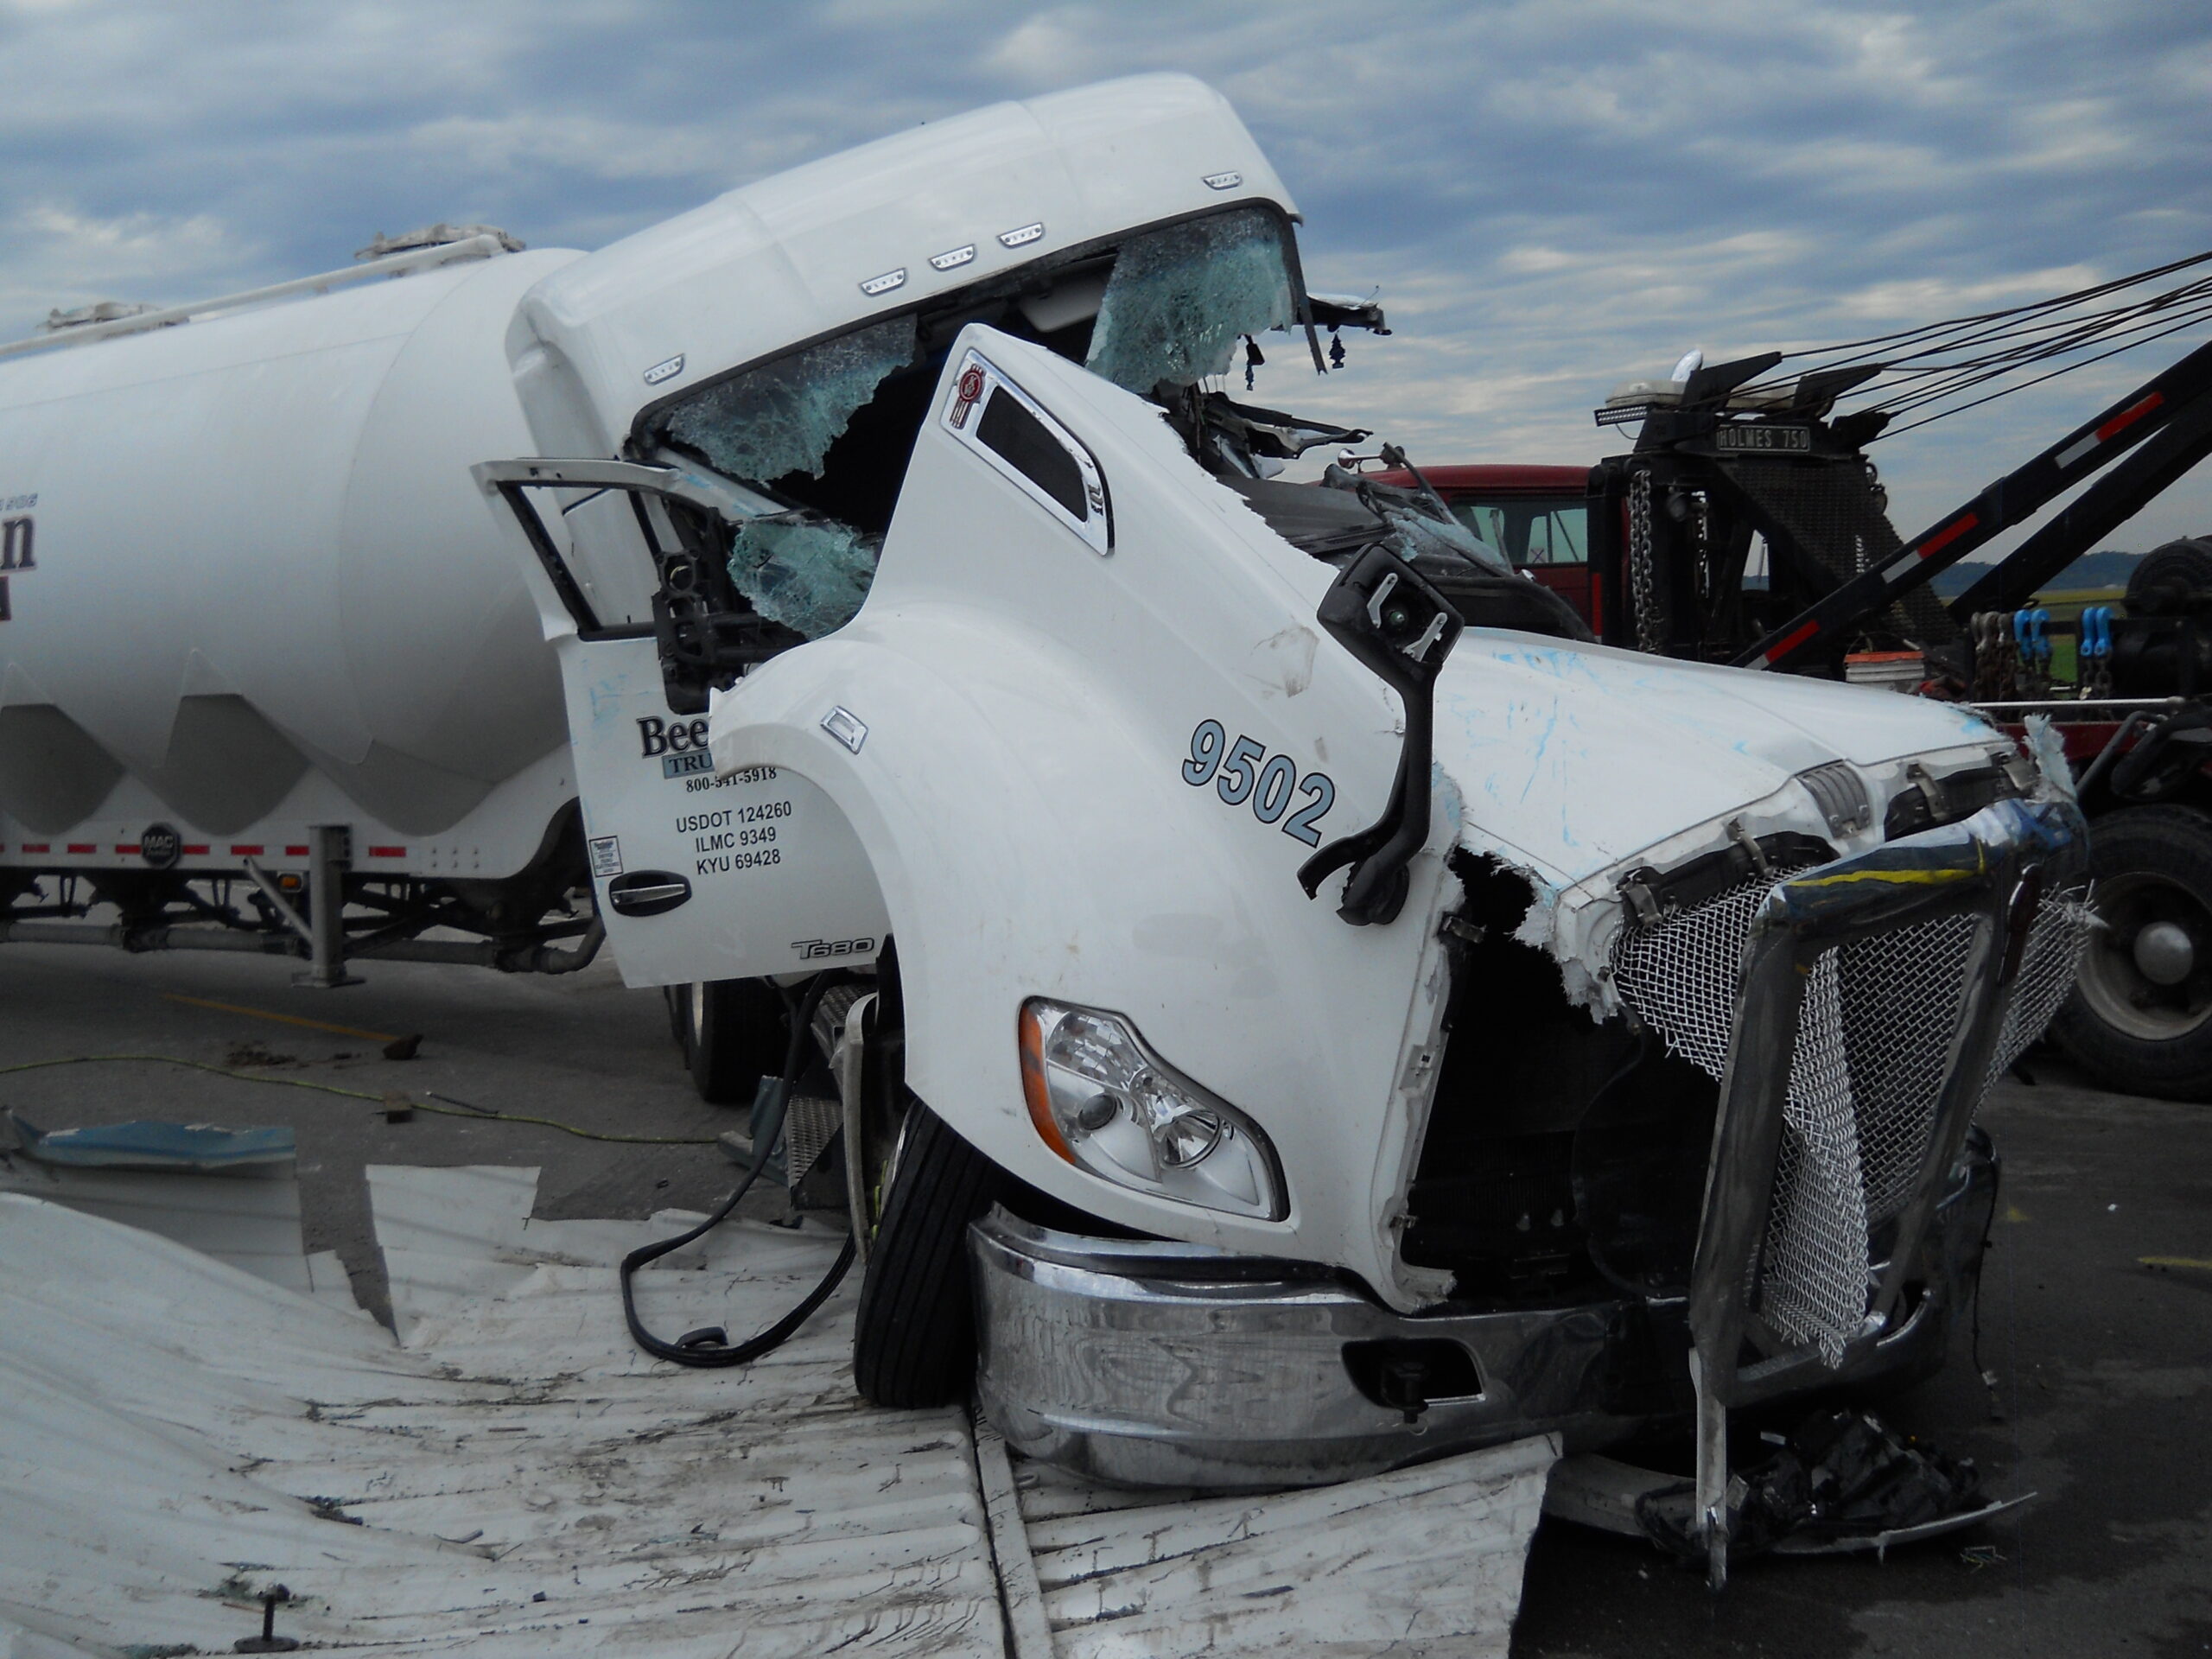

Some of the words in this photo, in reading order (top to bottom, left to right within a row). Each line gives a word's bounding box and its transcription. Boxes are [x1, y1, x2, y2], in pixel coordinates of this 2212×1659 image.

[1719, 429, 1771, 448] HOLMES
[1783, 430, 1808, 448] 750
[1181, 718, 1336, 849] 9502
[676, 810, 733, 833] USDOT
[737, 800, 792, 823] 124260
[695, 832, 735, 853] ILMC
[739, 826, 777, 846] 9349
[696, 855, 730, 875] KYU
[734, 848, 781, 869] 69428
[791, 937, 875, 960] T680
